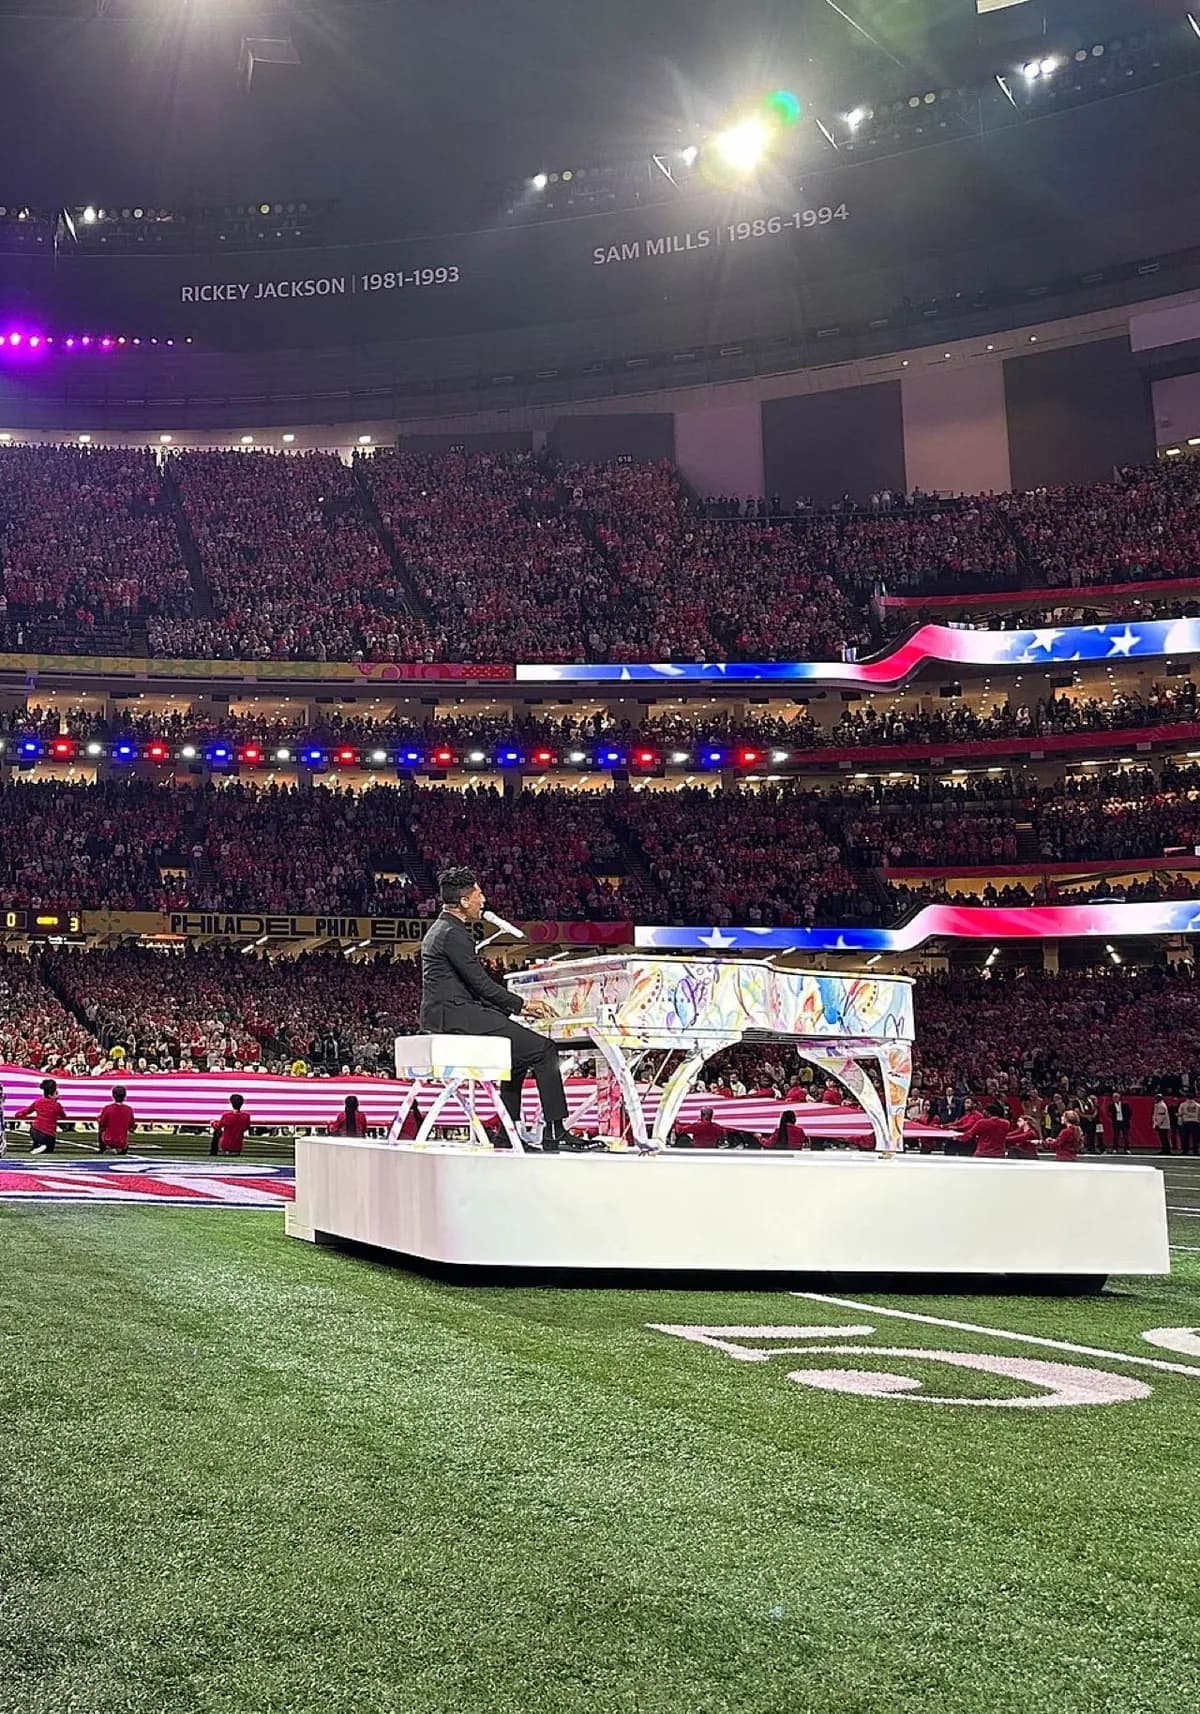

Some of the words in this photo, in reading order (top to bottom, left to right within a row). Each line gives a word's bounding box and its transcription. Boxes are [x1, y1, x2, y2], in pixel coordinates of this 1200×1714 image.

[593, 242, 640, 265] SAM
[646, 230, 711, 256] MILLS
[727, 203, 849, 242] 1986-1994
[181, 283, 250, 302] RICKEY
[254, 277, 346, 299] JACKSON
[361, 266, 460, 291] 1981-1993
[6, 911, 16, 928] 0
[70, 917, 79, 932] 3
[171, 914, 360, 937] PHILADELPHIA
[370, 918, 485, 941] EAGS
[646, 1324, 1200, 1407] 5
